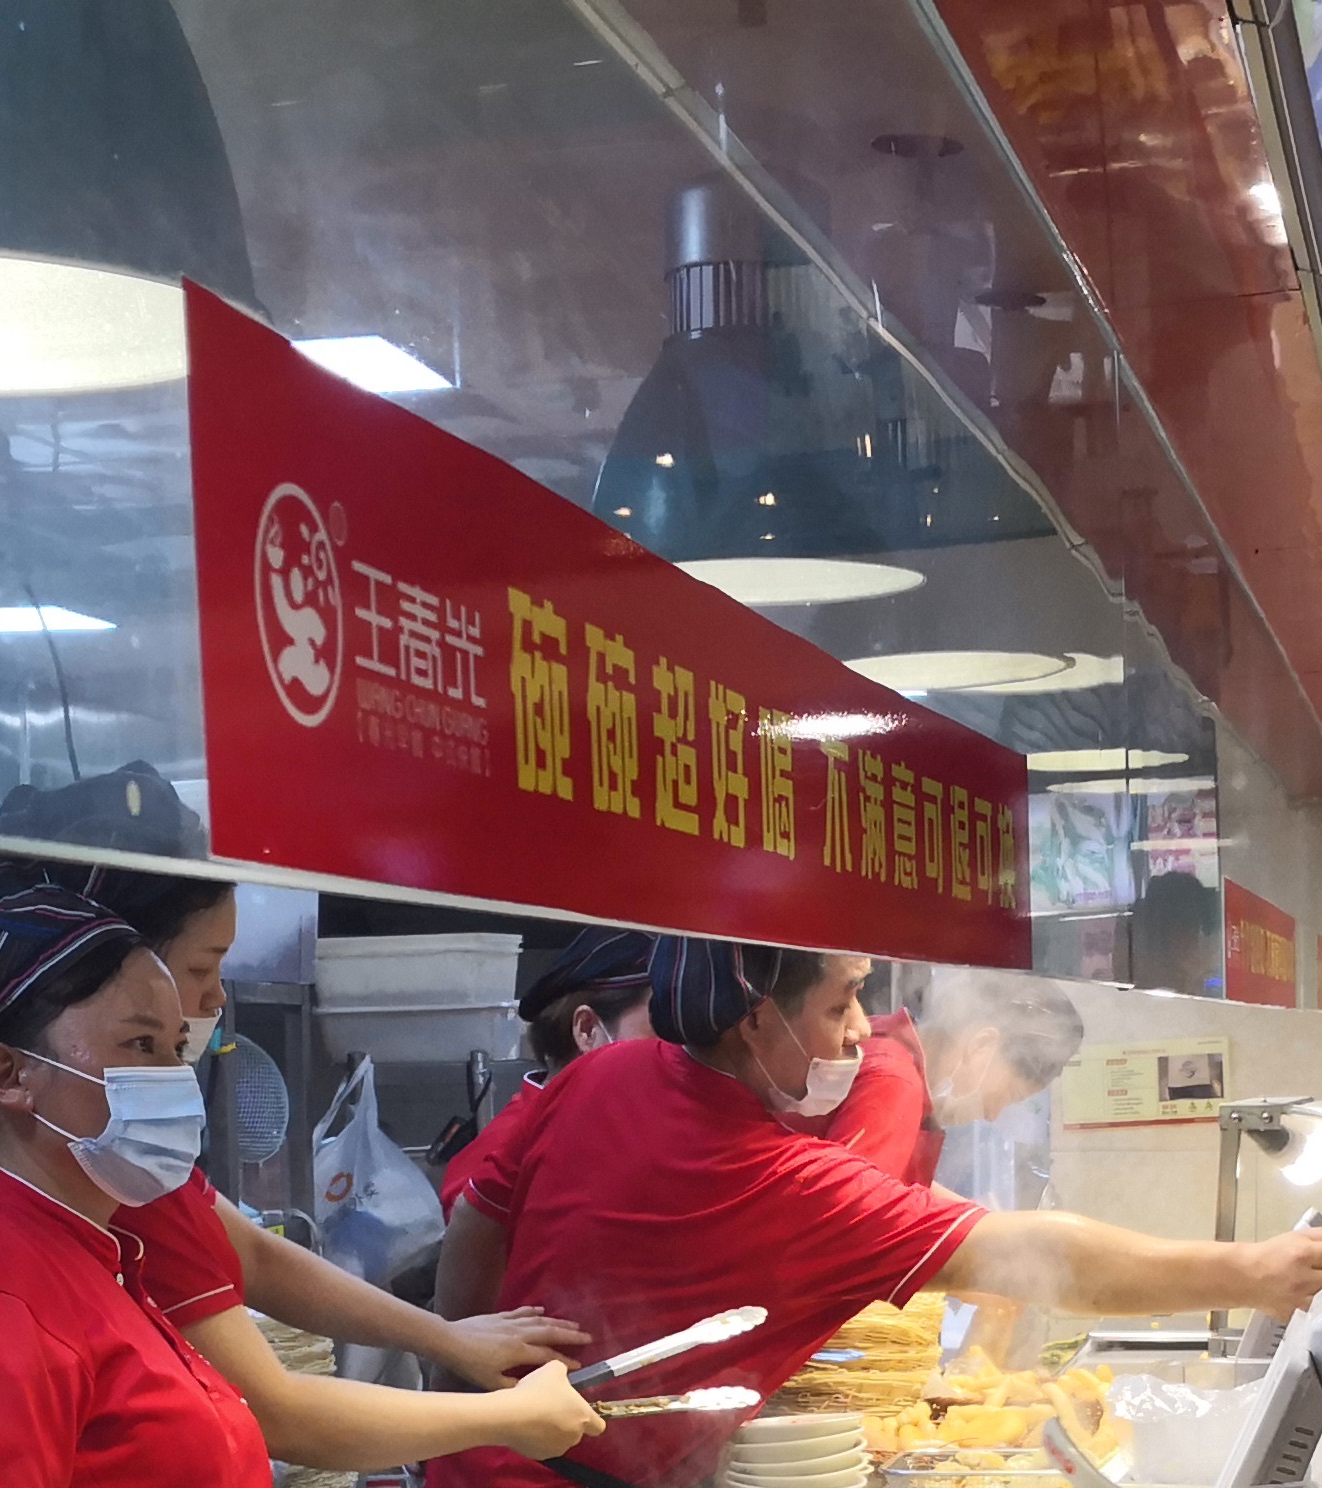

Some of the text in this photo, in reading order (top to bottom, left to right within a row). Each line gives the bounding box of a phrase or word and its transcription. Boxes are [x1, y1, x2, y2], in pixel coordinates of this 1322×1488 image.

[351, 559, 488, 709] 王春光
[507, 586, 1017, 910] 碗碗超好喝 不满意可退可换
